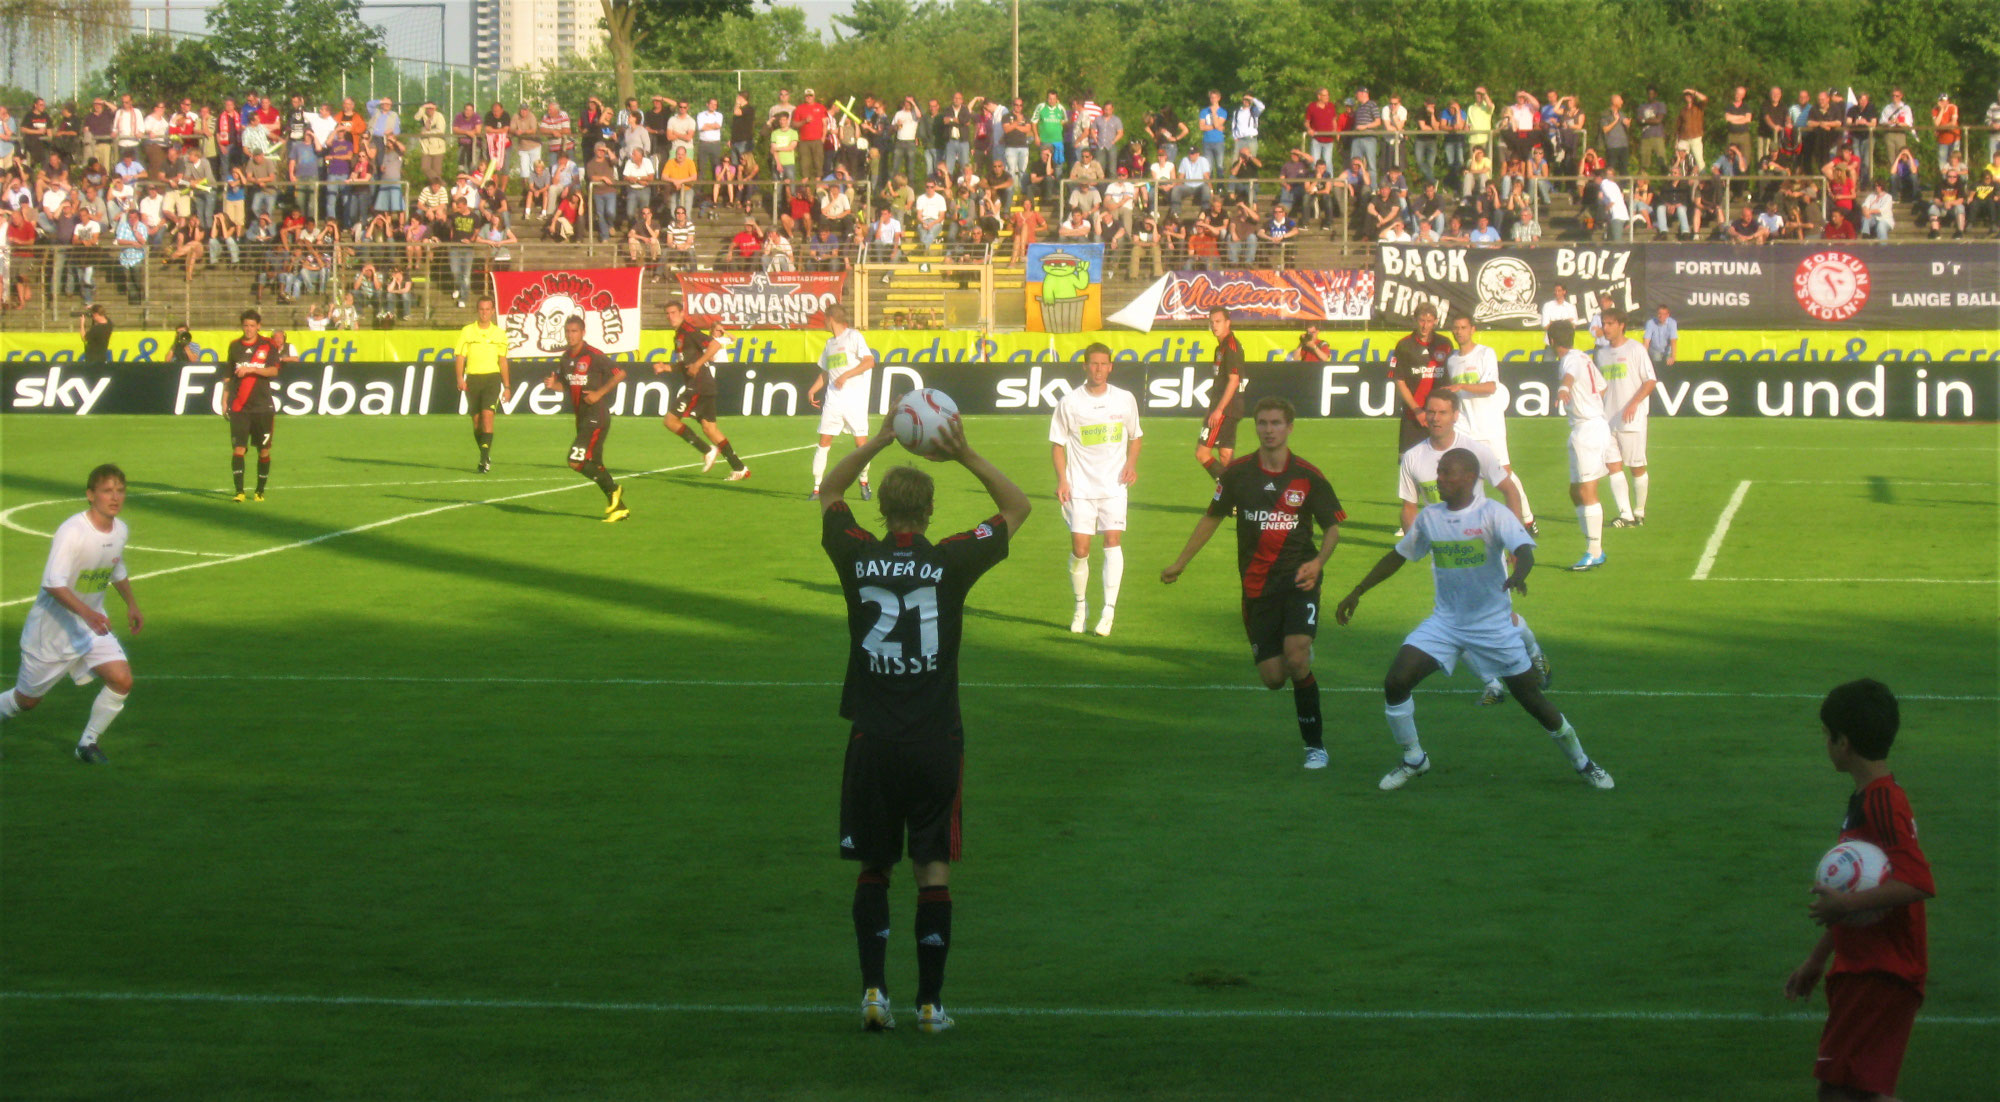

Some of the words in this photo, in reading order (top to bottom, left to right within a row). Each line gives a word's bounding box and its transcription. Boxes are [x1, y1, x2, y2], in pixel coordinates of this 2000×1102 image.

[1382, 246, 1469, 282] BACK
[1556, 248, 1631, 281] BOLZ
[1675, 261, 1762, 275] FORTUNA
[687, 292, 838, 315] KOMMANDO
[1687, 292, 1751, 306] JUNGS
[1892, 293, 1952, 307] LANGE
[1956, 292, 2000, 306] BALL
[13, 366, 111, 415] sky
[742, 369, 798, 416] in
[1757, 364, 1885, 417] und
[1916, 369, 1973, 417] in
[262, 433, 271, 446] 7
[569, 446, 587, 461] 23
[1260, 516, 1300, 531] ENERGY
[855, 559, 916, 579] BAYER
[919, 563, 944, 584] 04
[858, 585, 939, 658] 21
[1306, 602, 1317, 625] 2
[868, 652, 938, 675] RISSE
